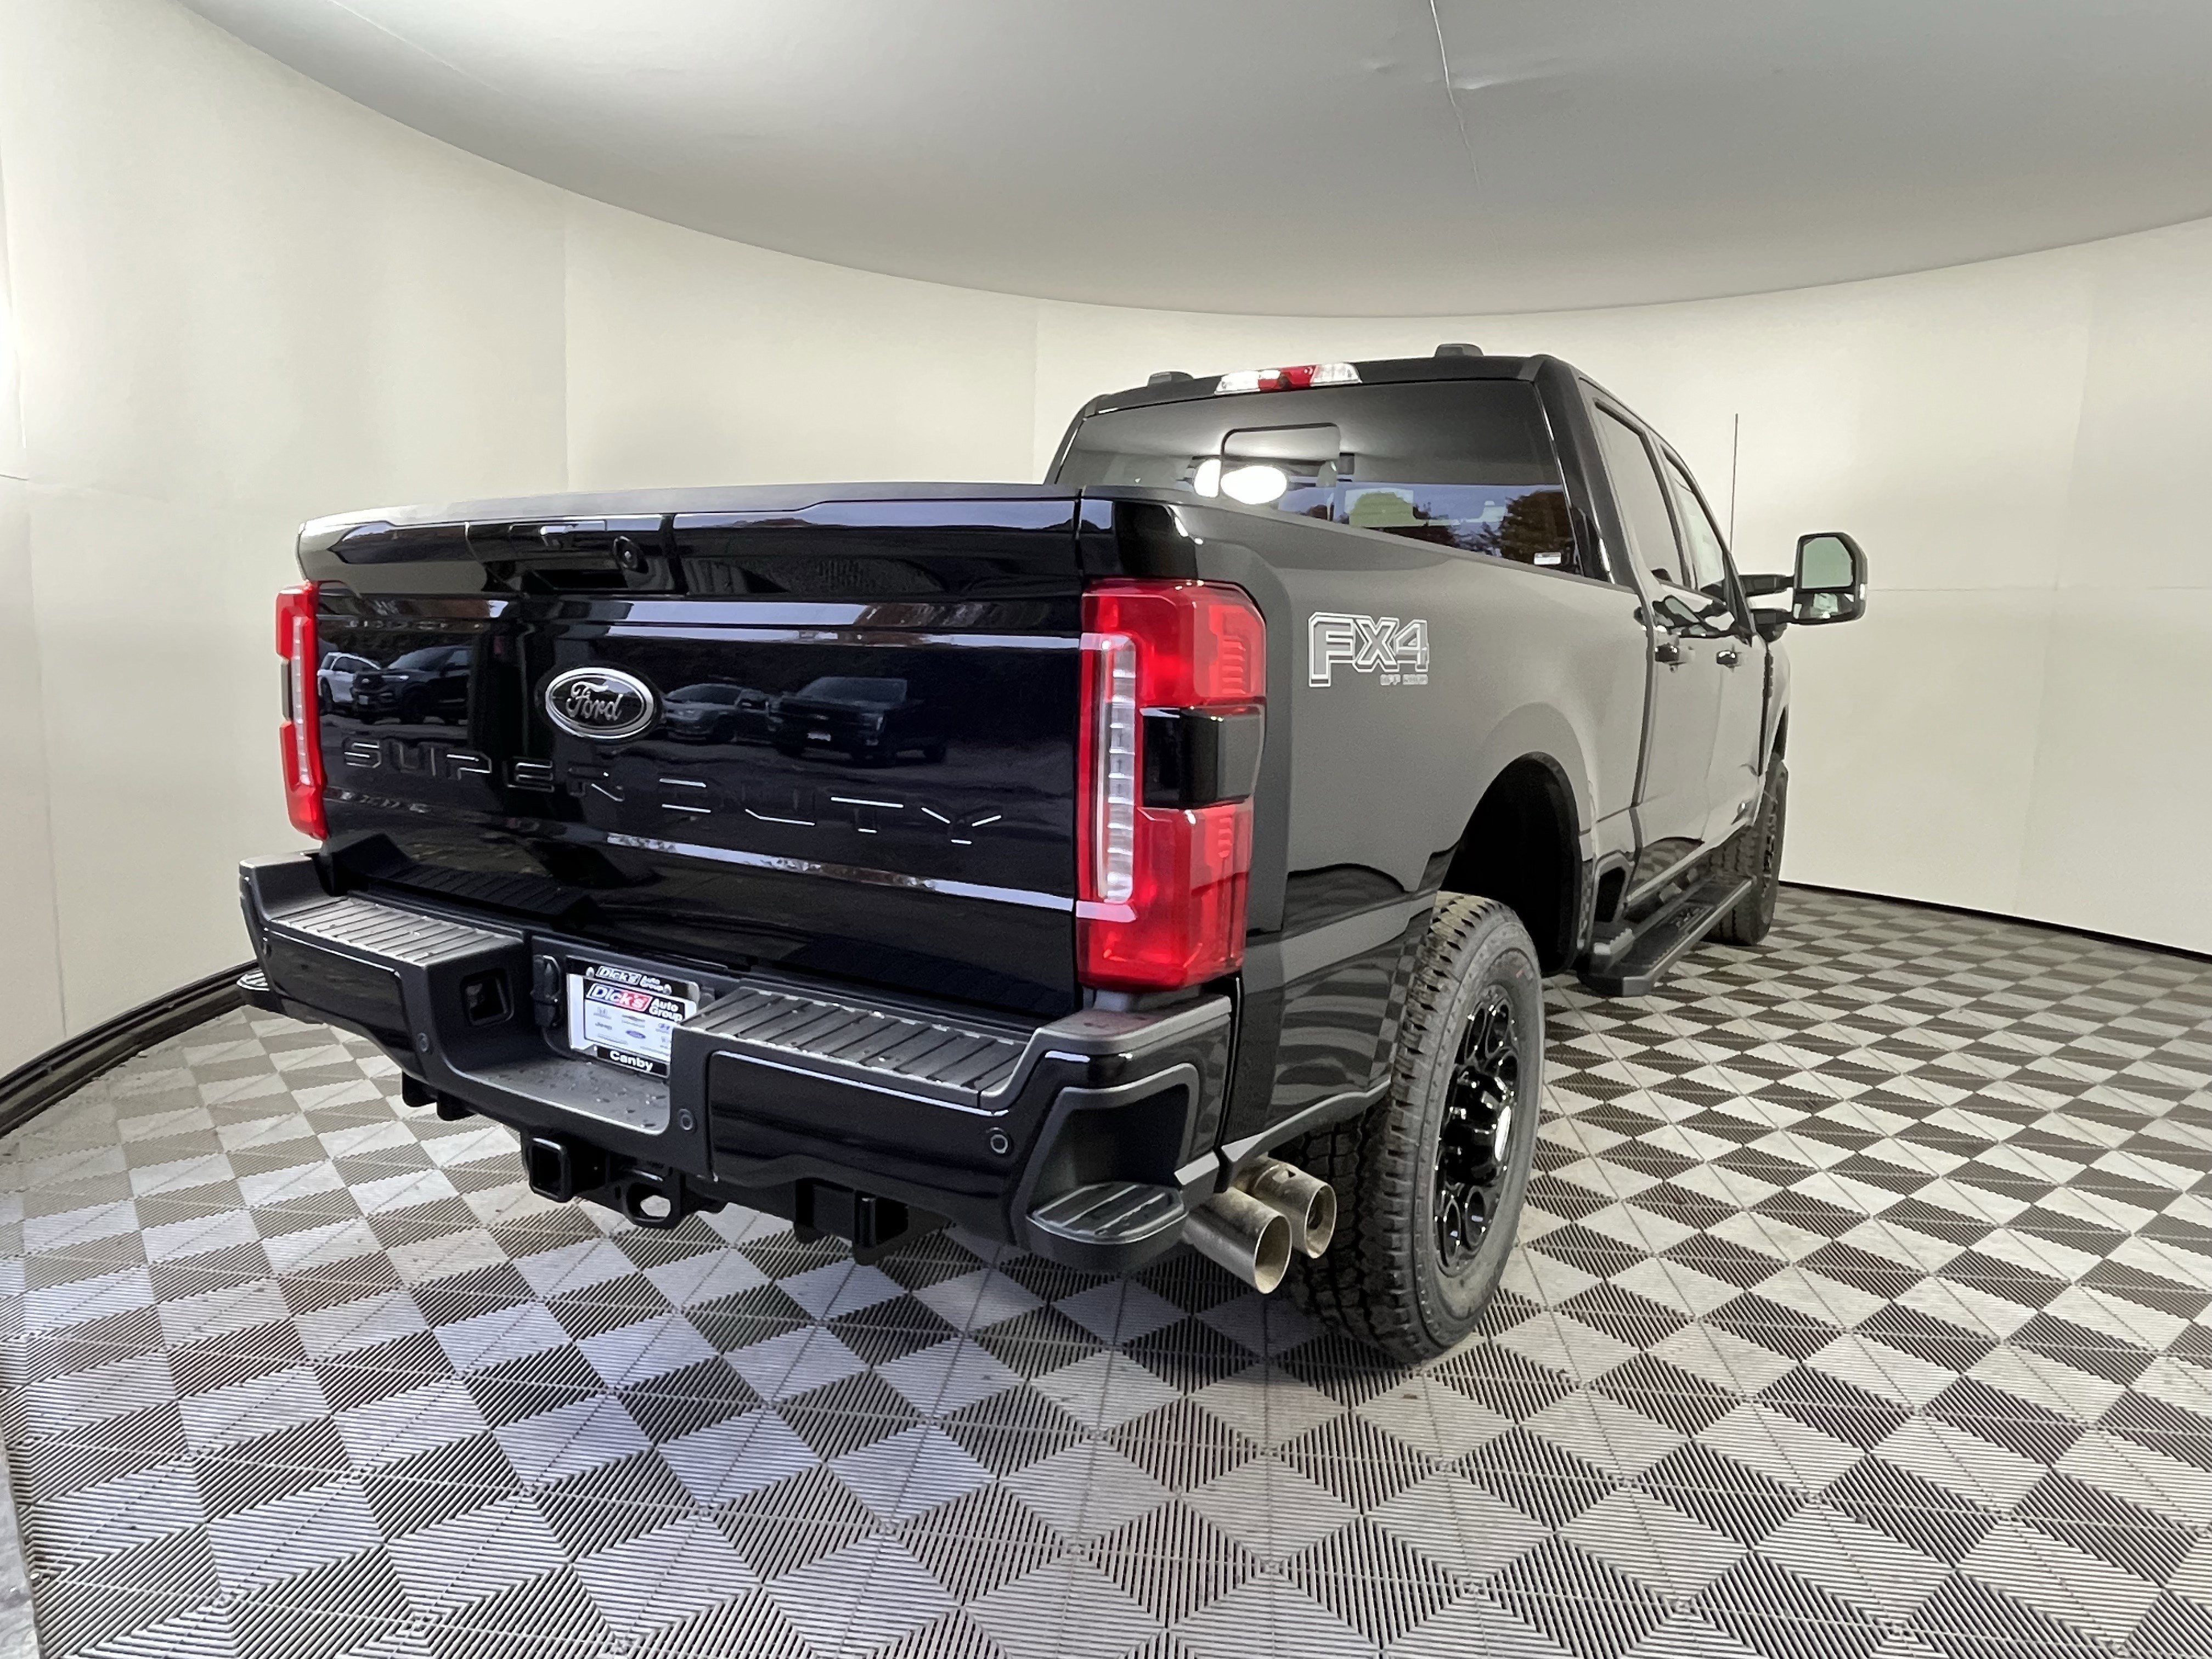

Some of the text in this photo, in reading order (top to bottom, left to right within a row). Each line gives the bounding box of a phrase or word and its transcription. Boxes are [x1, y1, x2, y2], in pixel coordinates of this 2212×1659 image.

[1308, 612, 1429, 687] FX4
[566, 681, 623, 720] Ford
[341, 737, 625, 803] SUPER
[648, 1006, 682, 1022] Group
[653, 999, 679, 1012] Auto
[608, 1050, 653, 1071] Canby
